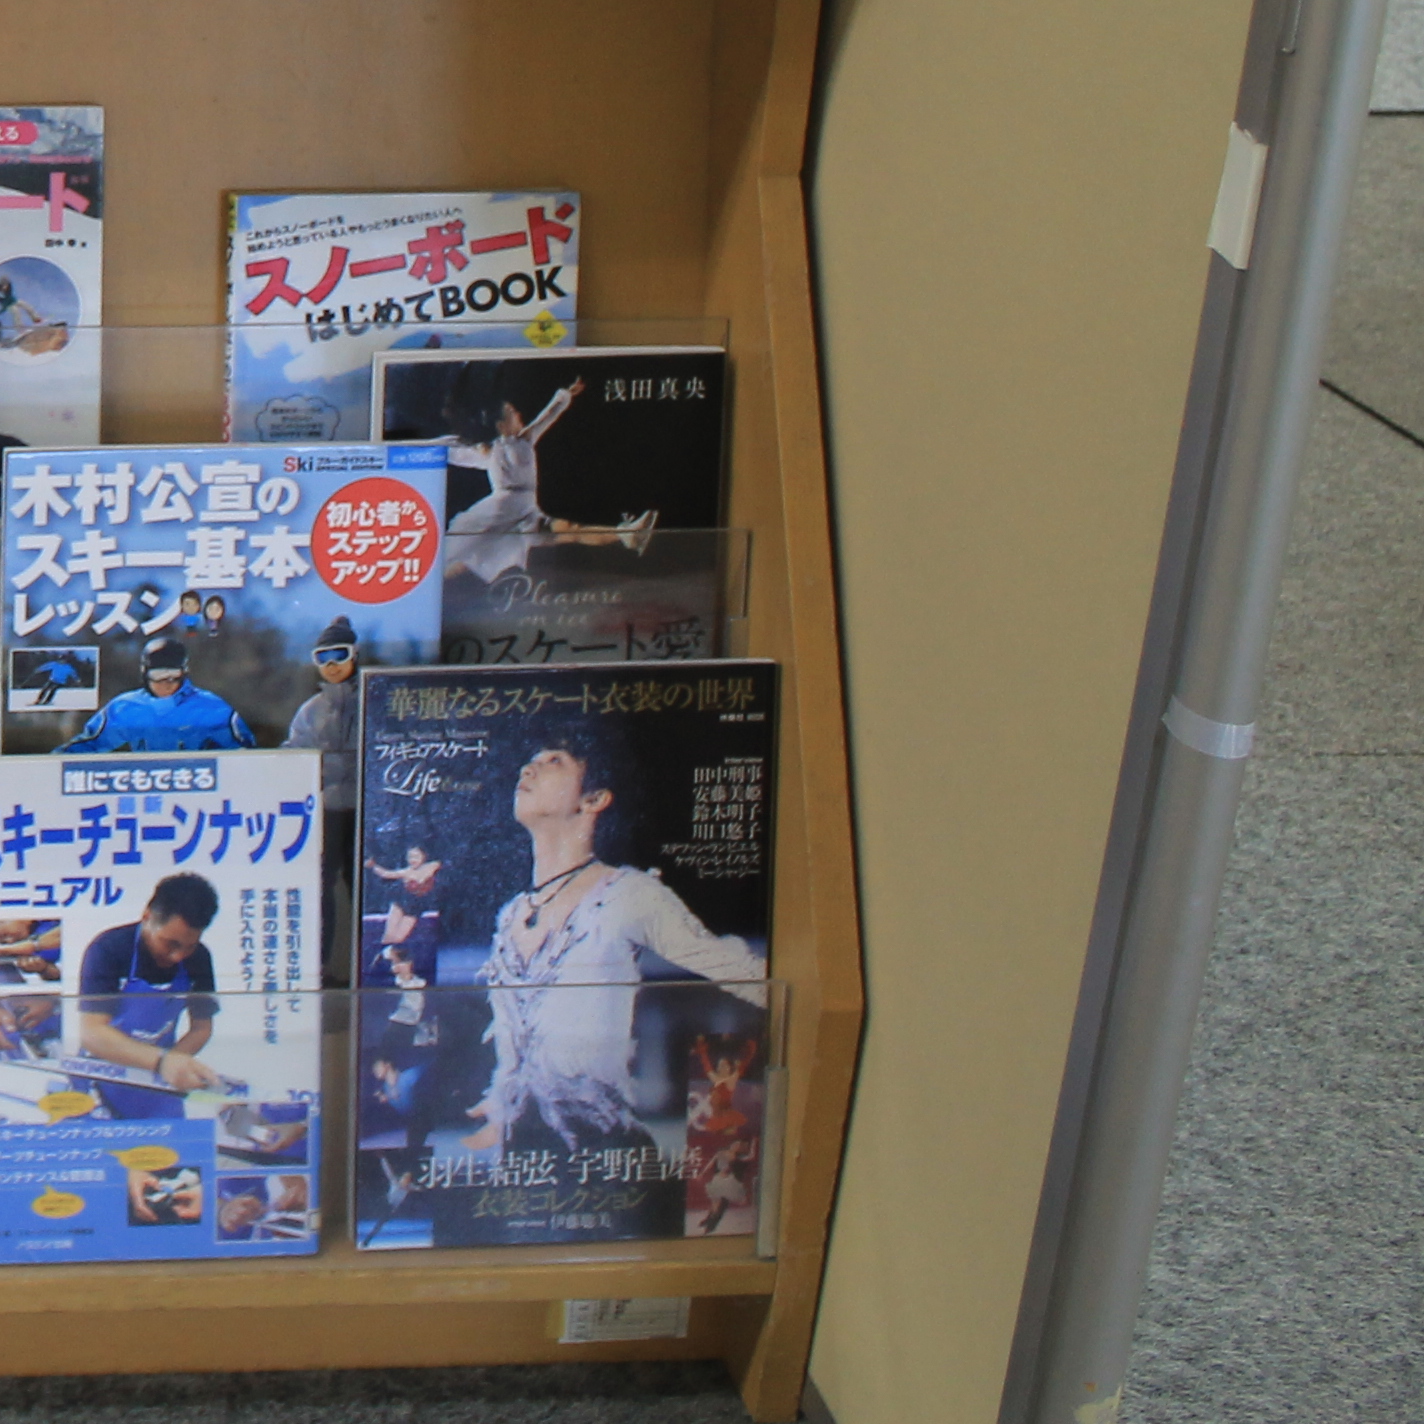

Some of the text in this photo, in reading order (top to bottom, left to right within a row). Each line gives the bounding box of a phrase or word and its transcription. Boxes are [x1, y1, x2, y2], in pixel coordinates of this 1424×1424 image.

[246, 214, 345, 242] これからスノーボードを
[245, 203, 576, 316] スノーボード
[304, 266, 567, 343] はじめてBOOK
[604, 379, 707, 401] 浅田真央
[283, 456, 314, 473] Ski
[10, 460, 301, 527] 木村公宣の
[327, 500, 427, 526] 初心者から
[328, 529, 427, 556] ステップ
[11, 525, 311, 592] スキー基本
[331, 558, 420, 586] アップ!!
[490, 576, 623, 613] Pleasure
[12, 590, 184, 637] レッスン
[386, 678, 756, 721] 華麗なるスケート衣装の世界
[375, 740, 488, 760] フィギュアスケート
[64, 766, 216, 794] 誰にでもできる
[382, 761, 442, 801] Life
[693, 766, 763, 784] 田中刑事
[117, 796, 163, 814] 最新
[693, 786, 762, 803] 安藤美姫
[692, 804, 762, 823] 鈴木明子
[692, 823, 762, 841] 川口悠子
[417, 1147, 704, 1189] 羽生結弦 宇野昌磨
[472, 1189, 647, 1218] 衣装コレクション
